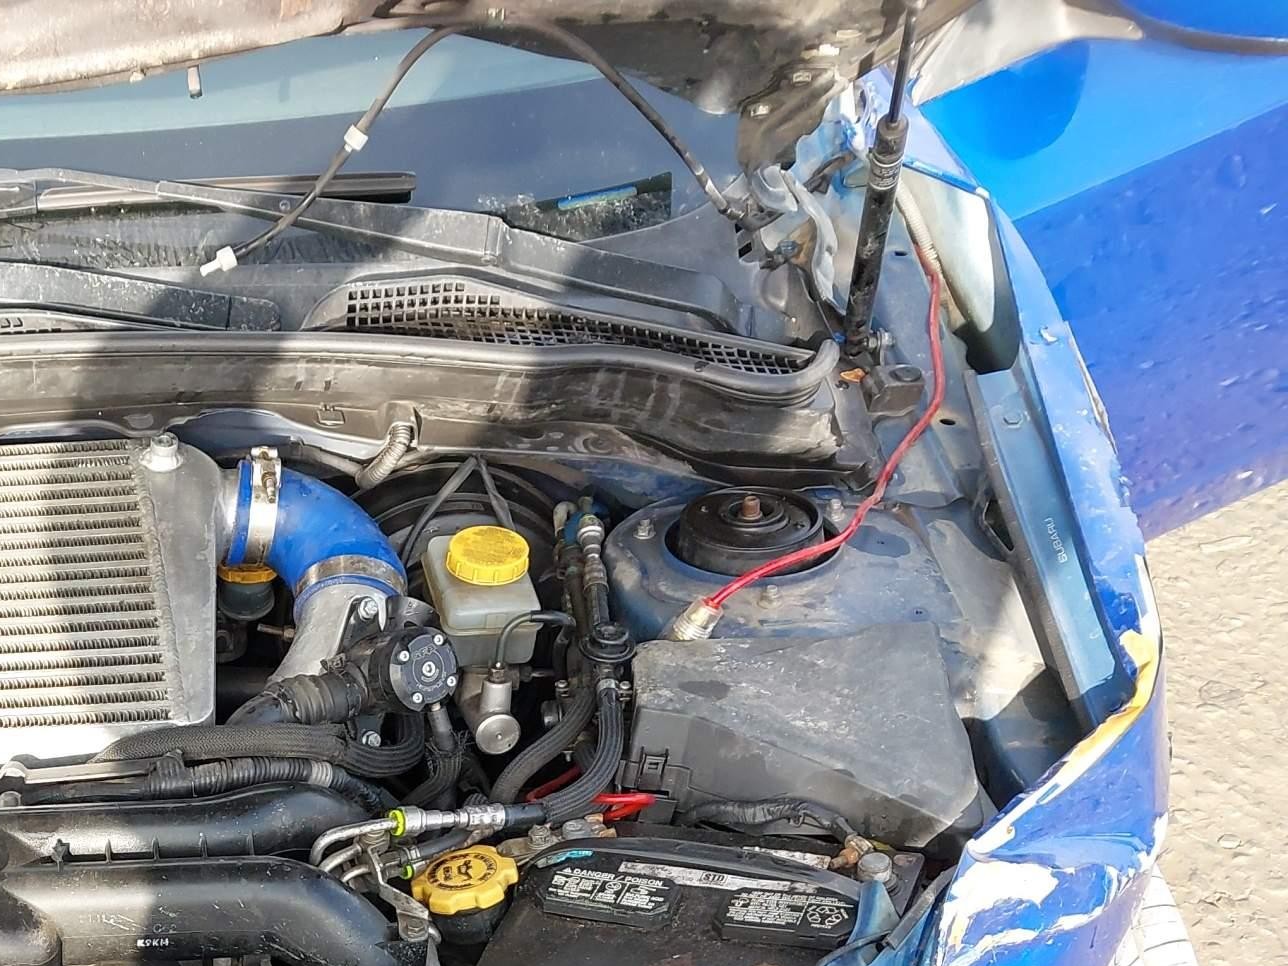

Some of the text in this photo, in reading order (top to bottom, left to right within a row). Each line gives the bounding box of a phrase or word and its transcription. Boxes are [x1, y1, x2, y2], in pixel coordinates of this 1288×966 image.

[1044, 517, 1068, 563] SUBARU
[573, 867, 615, 881] DANGER
[624, 876, 664, 887] POISON
[703, 873, 725, 882] STD
